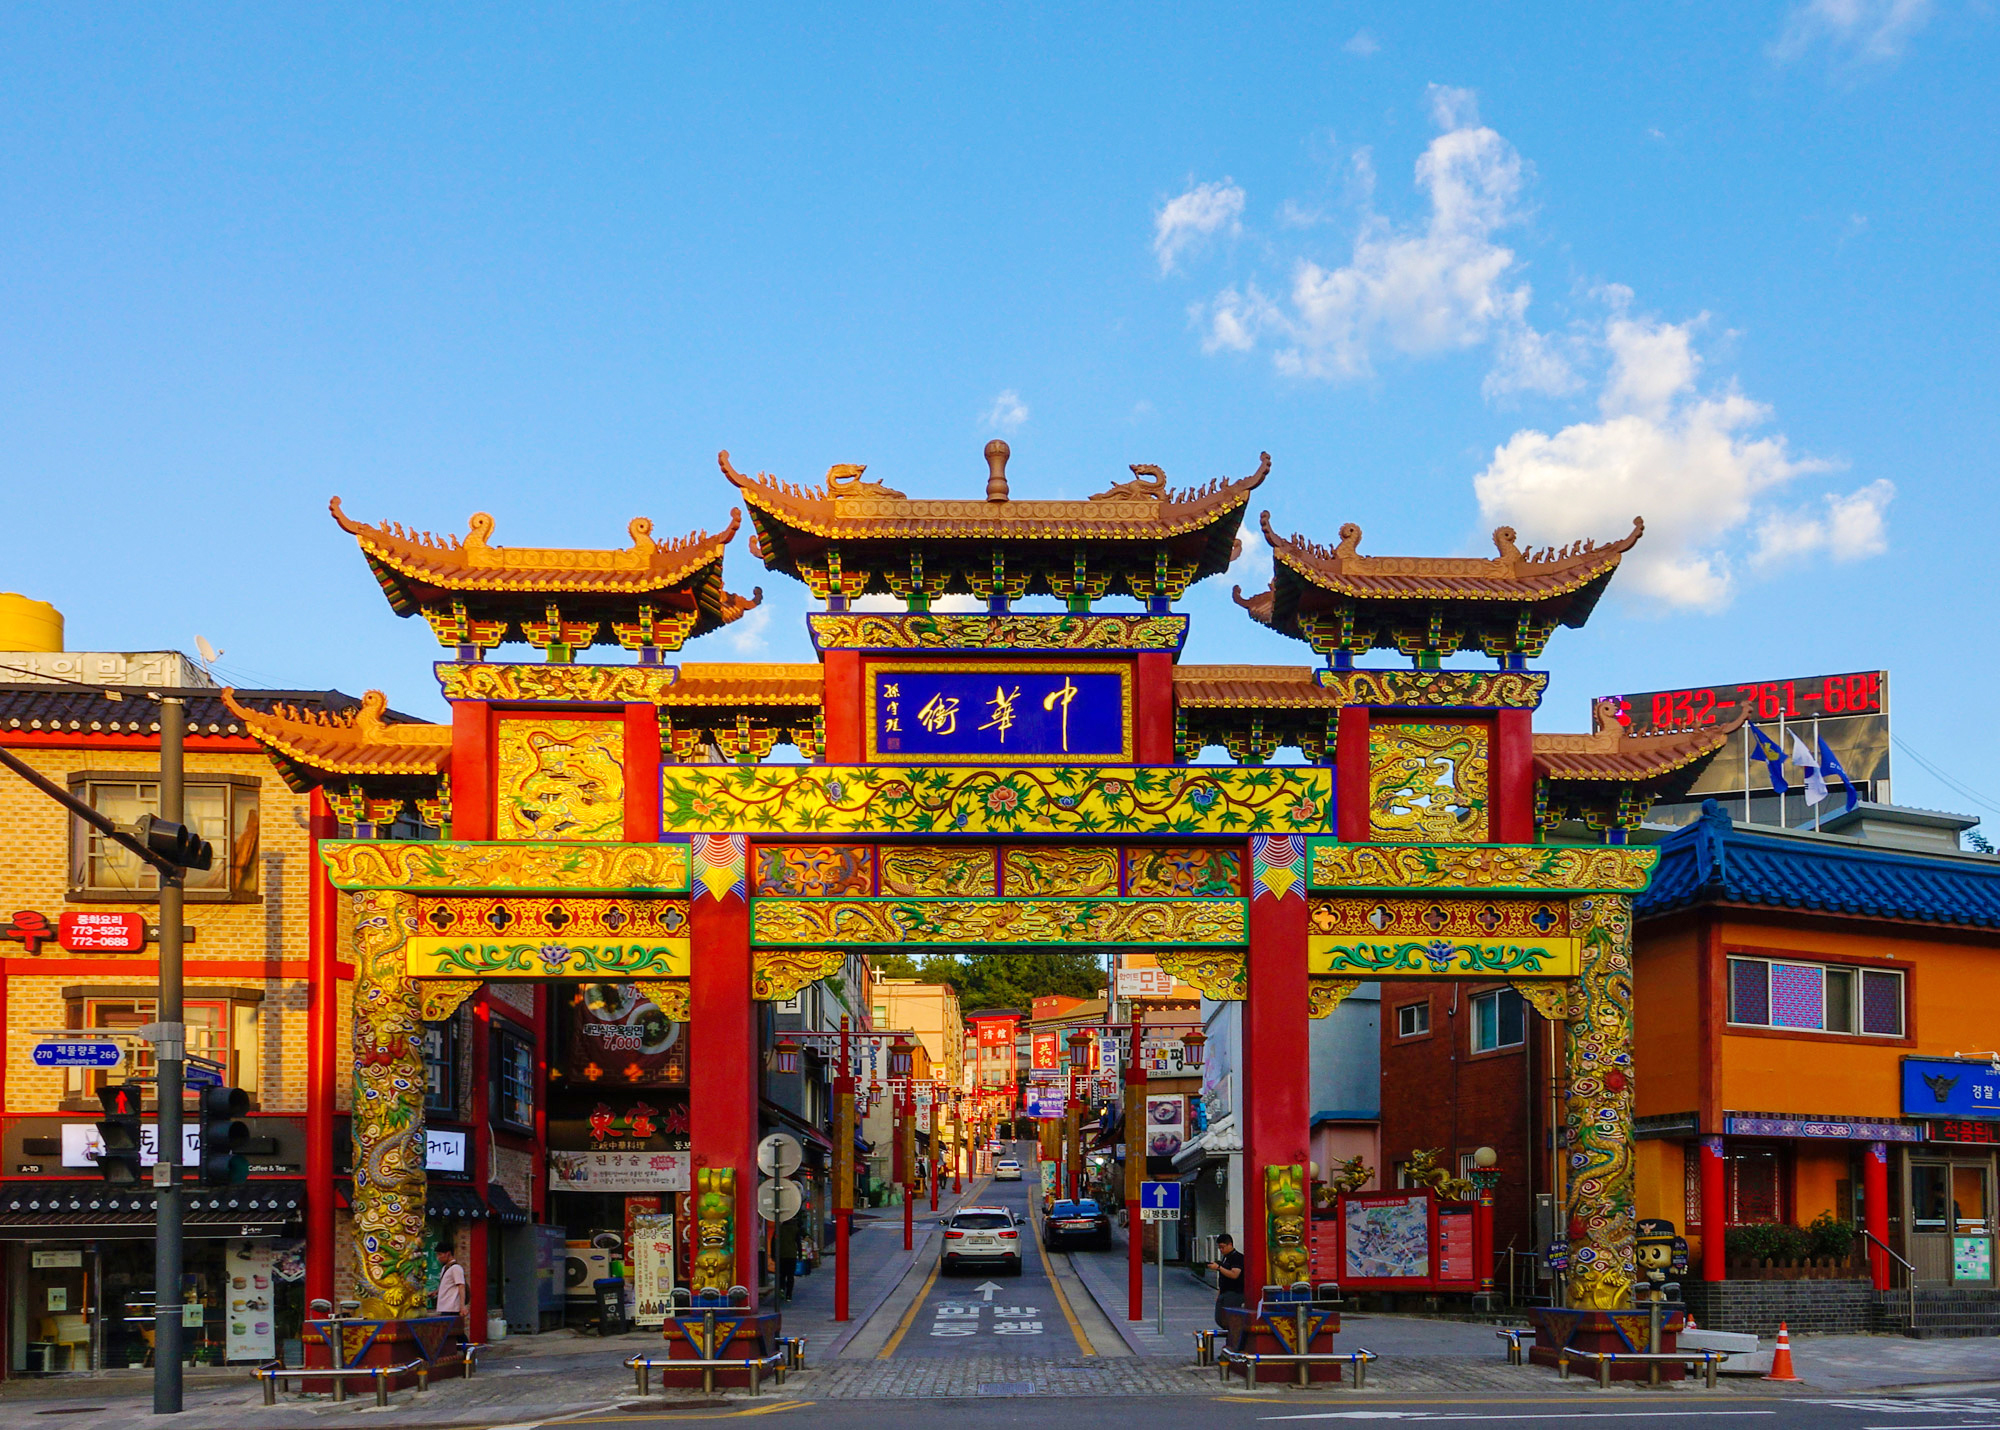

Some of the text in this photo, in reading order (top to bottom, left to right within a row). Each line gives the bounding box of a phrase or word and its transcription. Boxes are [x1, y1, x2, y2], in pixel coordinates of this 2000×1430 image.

[77, 915, 123, 925] 중화요리
[71, 926, 129, 936] 773-5257
[71, 937, 129, 947] 772-0688
[1119, 971, 1171, 993] 화이트 모텔
[603, 1037, 642, 1051] 7,000
[36, 1045, 117, 1059] 270 제물량로 266
[54, 1057, 98, 1066] Jemullyang-ro
[1972, 1084, 1994, 1100] 경찰
[1028, 1092, 1039, 1107] P
[920, 1104, 929, 1130] 부동산
[427, 1140, 459, 1156] 커피
[595, 1154, 641, 1167] 된장술
[22, 1165, 39, 1173] A-TO
[1142, 1209, 1179, 1219] 일방통행
